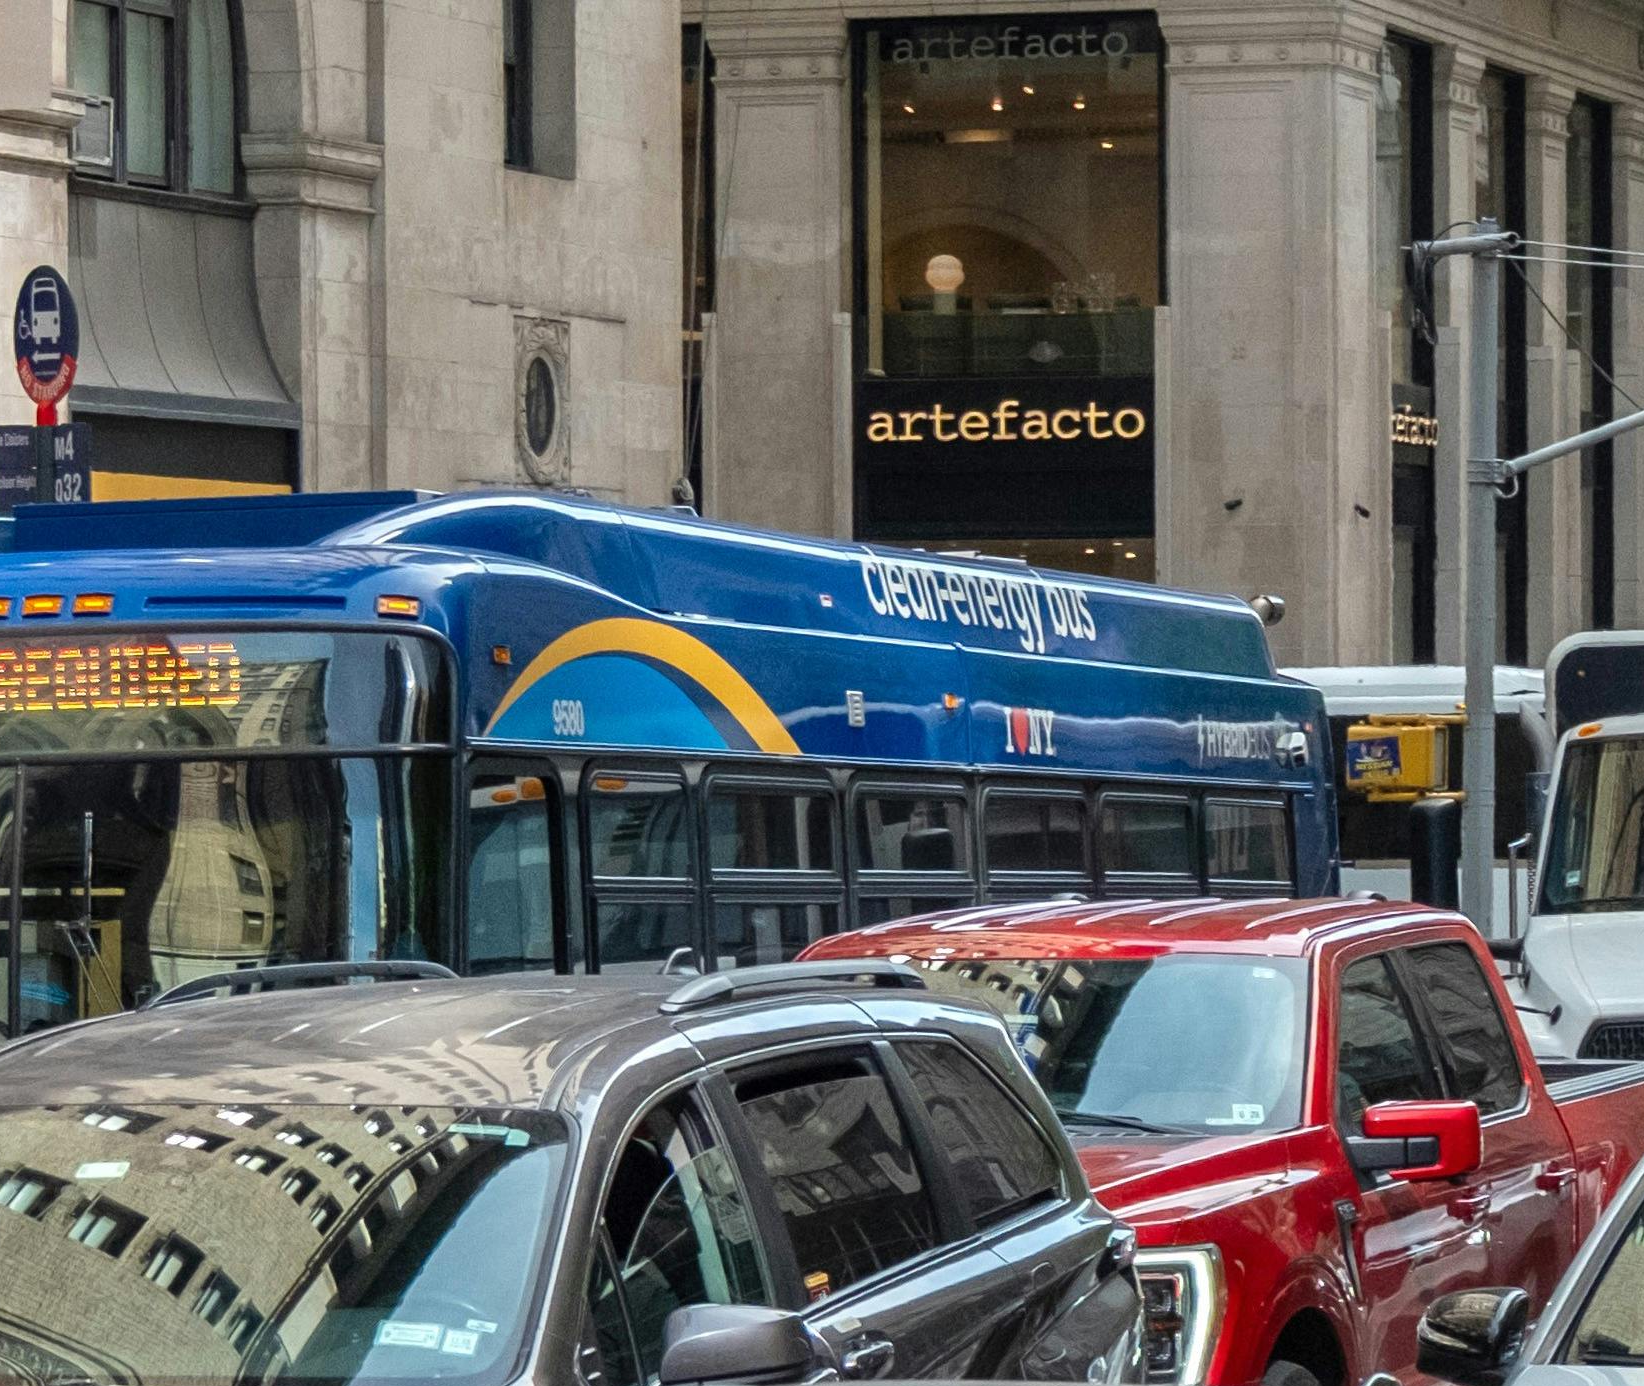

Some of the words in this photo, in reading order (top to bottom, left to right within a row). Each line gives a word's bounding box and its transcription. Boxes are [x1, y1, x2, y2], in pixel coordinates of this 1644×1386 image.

[892, 25, 1129, 63] artefacto
[867, 400, 1145, 444] artefacto
[54, 430, 75, 461] M4
[55, 472, 82, 503] Q32
[862, 560, 1046, 655] clean-energy
[1043, 580, 1097, 641] bus
[552, 698, 586, 738] 9580
[1004, 706, 1015, 754] I
[1029, 709, 1055, 757] NY
